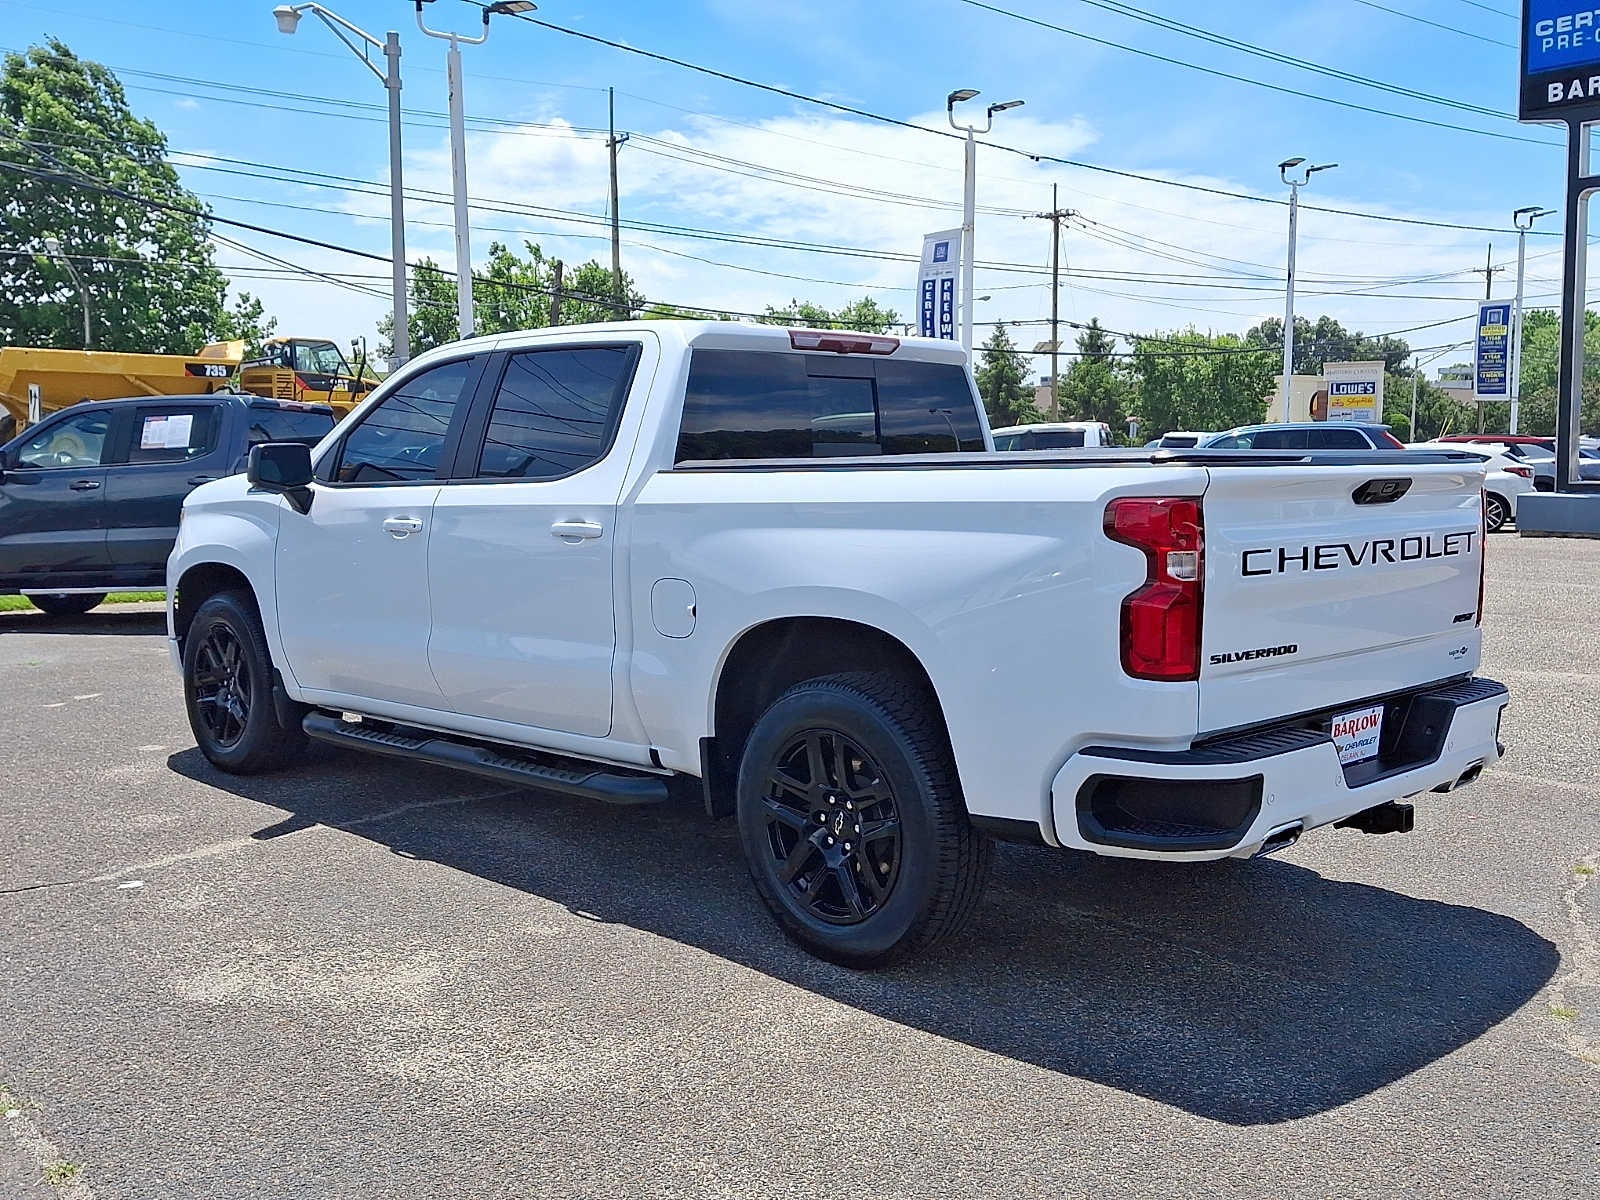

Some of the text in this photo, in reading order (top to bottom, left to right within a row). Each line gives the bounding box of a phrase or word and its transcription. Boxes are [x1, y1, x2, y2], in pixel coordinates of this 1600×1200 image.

[204, 365, 227, 377] 735
[1332, 382, 1374, 394] LOWE'S
[1241, 531, 1477, 577] CHEVROLET
[1209, 644, 1298, 665] SILVERADO
[1333, 713, 1381, 739] BARLOW
